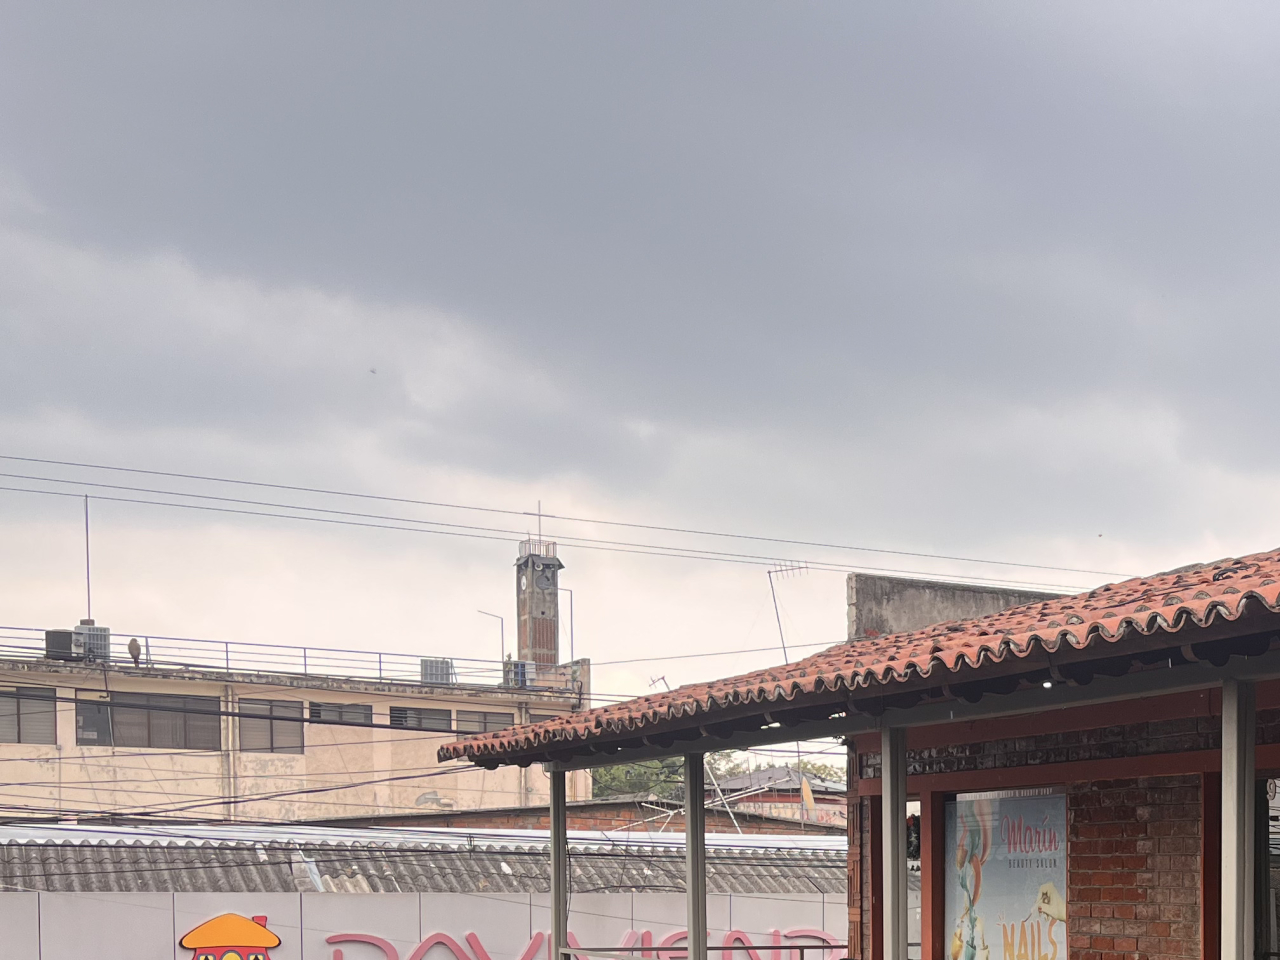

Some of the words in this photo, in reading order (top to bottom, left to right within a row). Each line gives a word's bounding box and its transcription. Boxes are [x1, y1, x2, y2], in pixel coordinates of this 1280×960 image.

[1266, 778, 1276, 801] 9
[1001, 814, 1060, 854] Marín
[1008, 858, 1032, 868] BEAUTY
[1036, 858, 1057, 868] SALON
